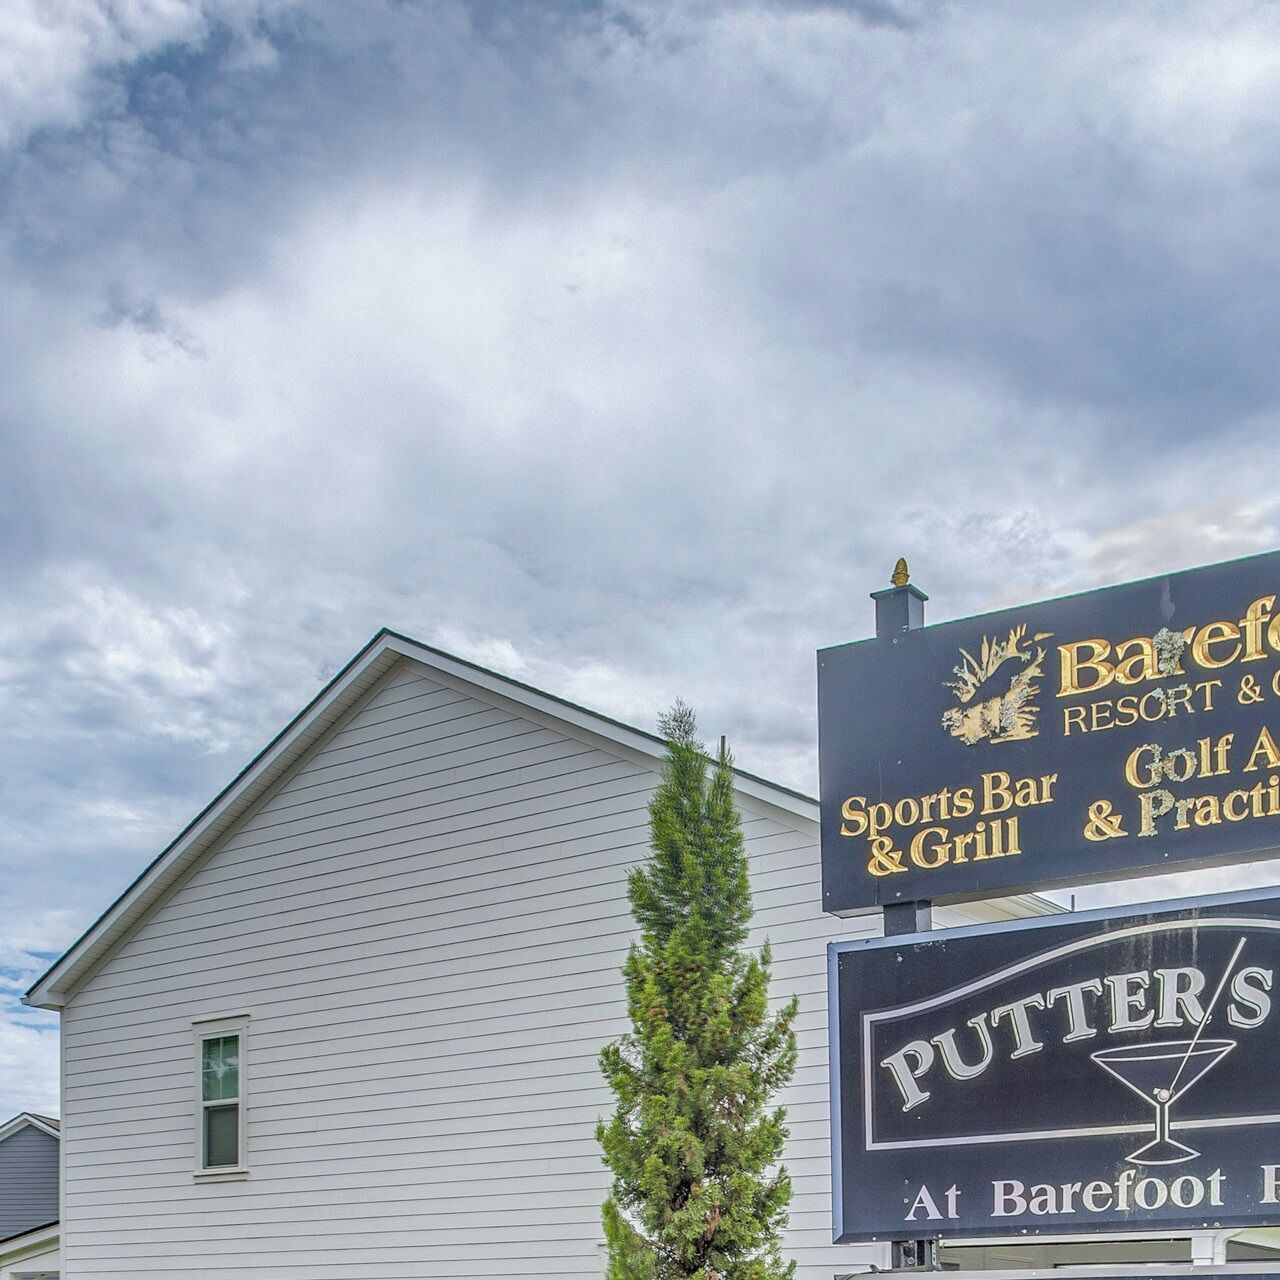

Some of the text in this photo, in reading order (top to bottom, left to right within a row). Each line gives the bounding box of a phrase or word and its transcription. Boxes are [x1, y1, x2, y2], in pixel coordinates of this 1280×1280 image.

[1063, 679, 1223, 736] RESORT
[1238, 674, 1264, 706] &
[1125, 730, 1235, 790] Golf
[840, 770, 1058, 840] Sports Bar
[1083, 800, 1129, 842] &
[867, 816, 1022, 877] & Grill
[904, 1182, 961, 1222] At
[991, 1167, 1226, 1217] Barefoot
